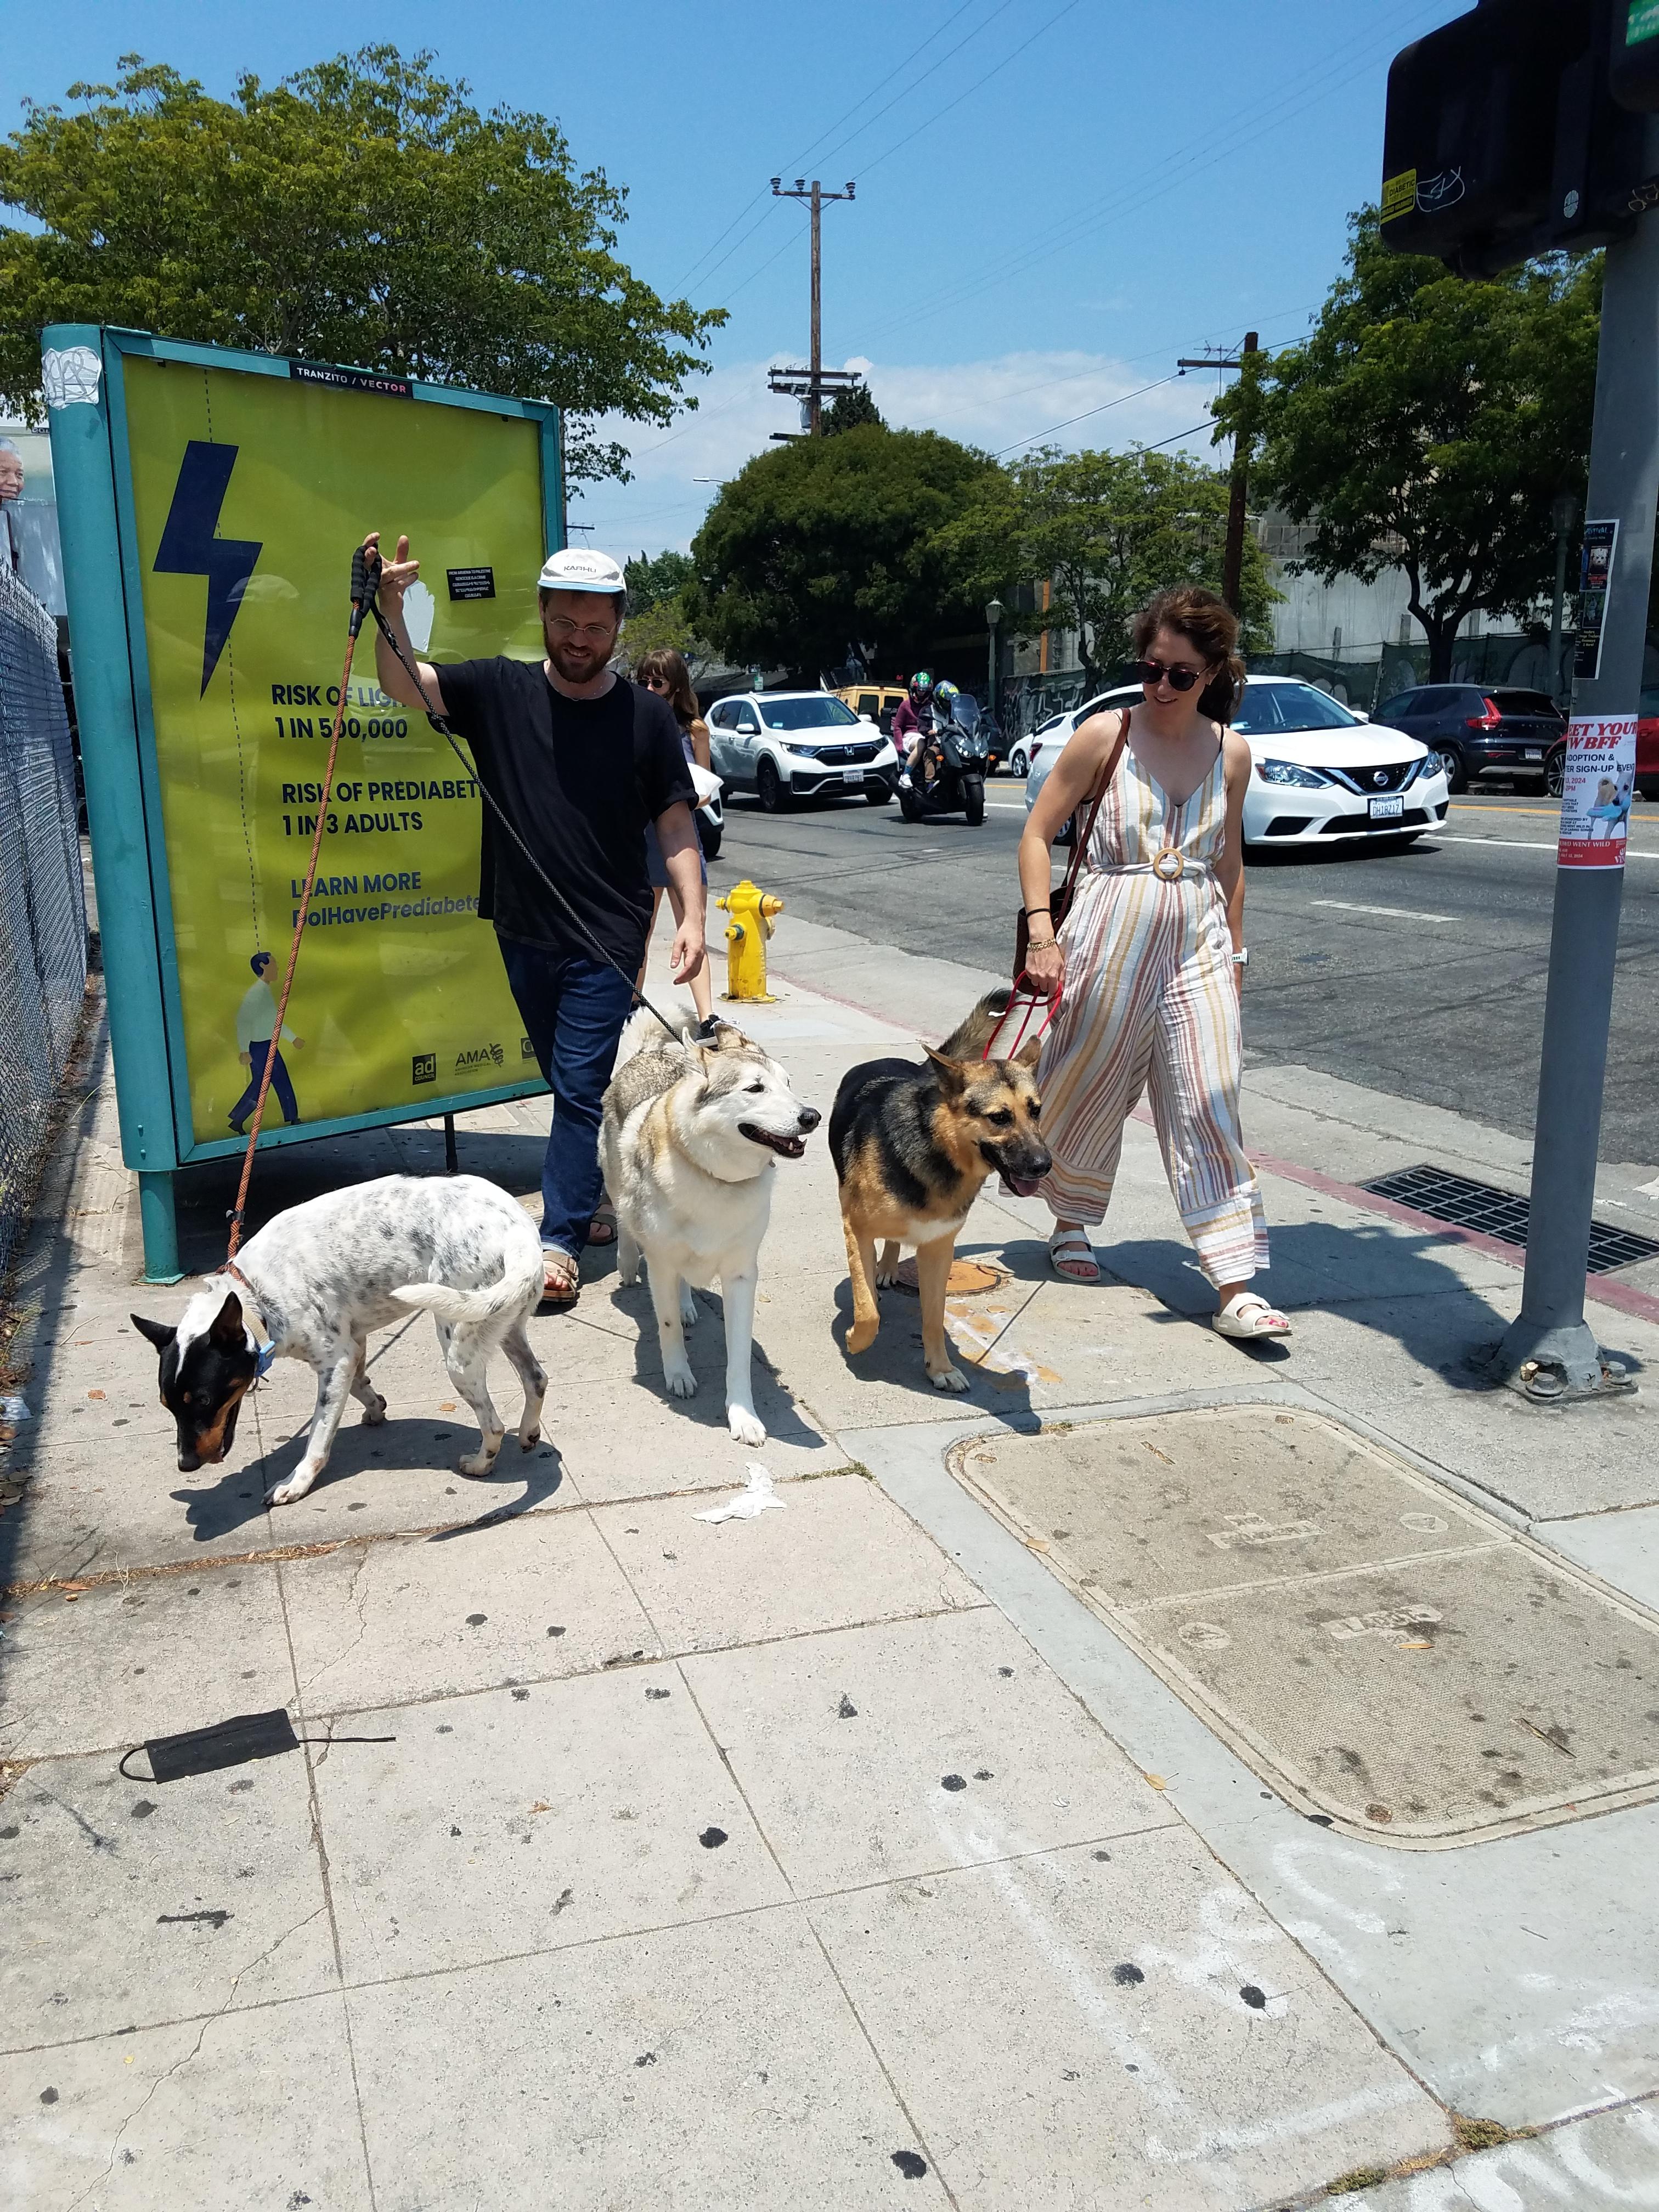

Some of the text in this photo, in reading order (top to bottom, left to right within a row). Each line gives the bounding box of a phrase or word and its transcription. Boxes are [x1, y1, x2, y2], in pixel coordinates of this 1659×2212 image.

[1389, 179, 1415, 196] DIABETIC
[296, 367, 347, 383] TRANZITO
[360, 378, 406, 393] VECTOR
[272, 684, 322, 706] RISK
[358, 687, 408, 707] LIG
[275, 716, 284, 738] 1
[290, 718, 313, 738] IN
[1569, 723, 1594, 736] EET
[1583, 736, 1622, 749] BFF
[282, 780, 482, 803] RISK OF PREDIABET
[283, 811, 423, 836] 1 IN 3 ADULTS
[363, 872, 421, 894] MORE
[293, 895, 479, 928] DoIHavePrediabete
[415, 1056, 434, 1075] ad
[456, 1048, 490, 1066] AMA
